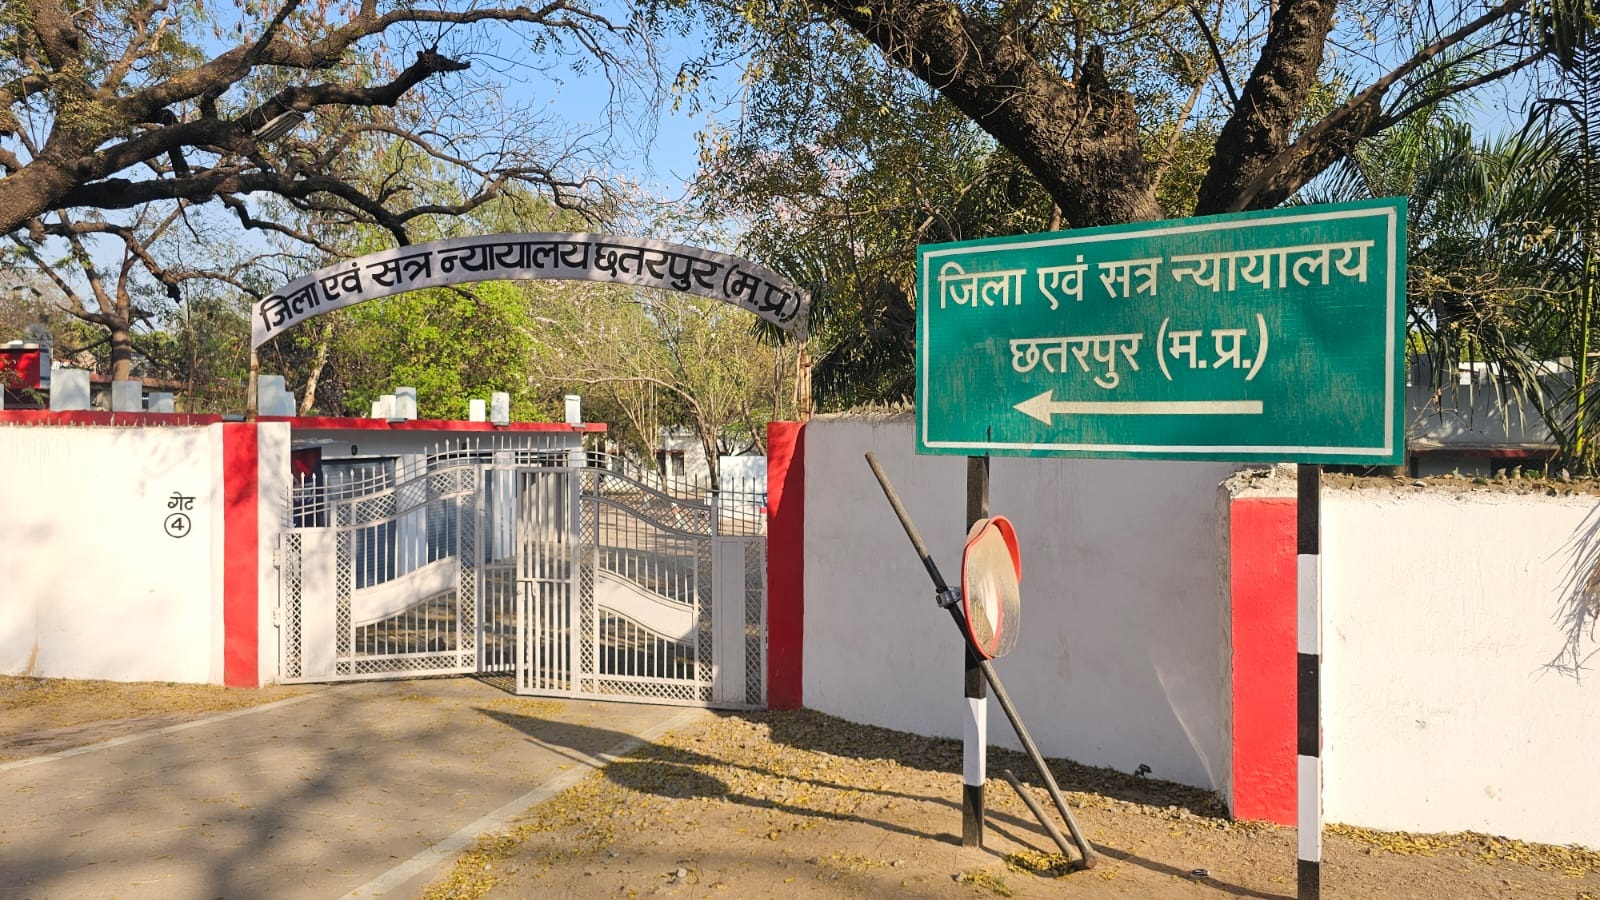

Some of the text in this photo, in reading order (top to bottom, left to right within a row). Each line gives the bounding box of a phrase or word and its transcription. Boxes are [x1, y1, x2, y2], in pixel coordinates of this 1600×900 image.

[259, 241, 800, 331] जिला एवं सत्र न्यायालय छतरपुर (म.प्र.)
[938, 240, 1375, 310] जिला एवं सत्र न्यायालय
[1009, 313, 1269, 389] छतरपुर (म.प्र.)
[167, 491, 196, 511] गेट
[170, 517, 184, 530] 4
